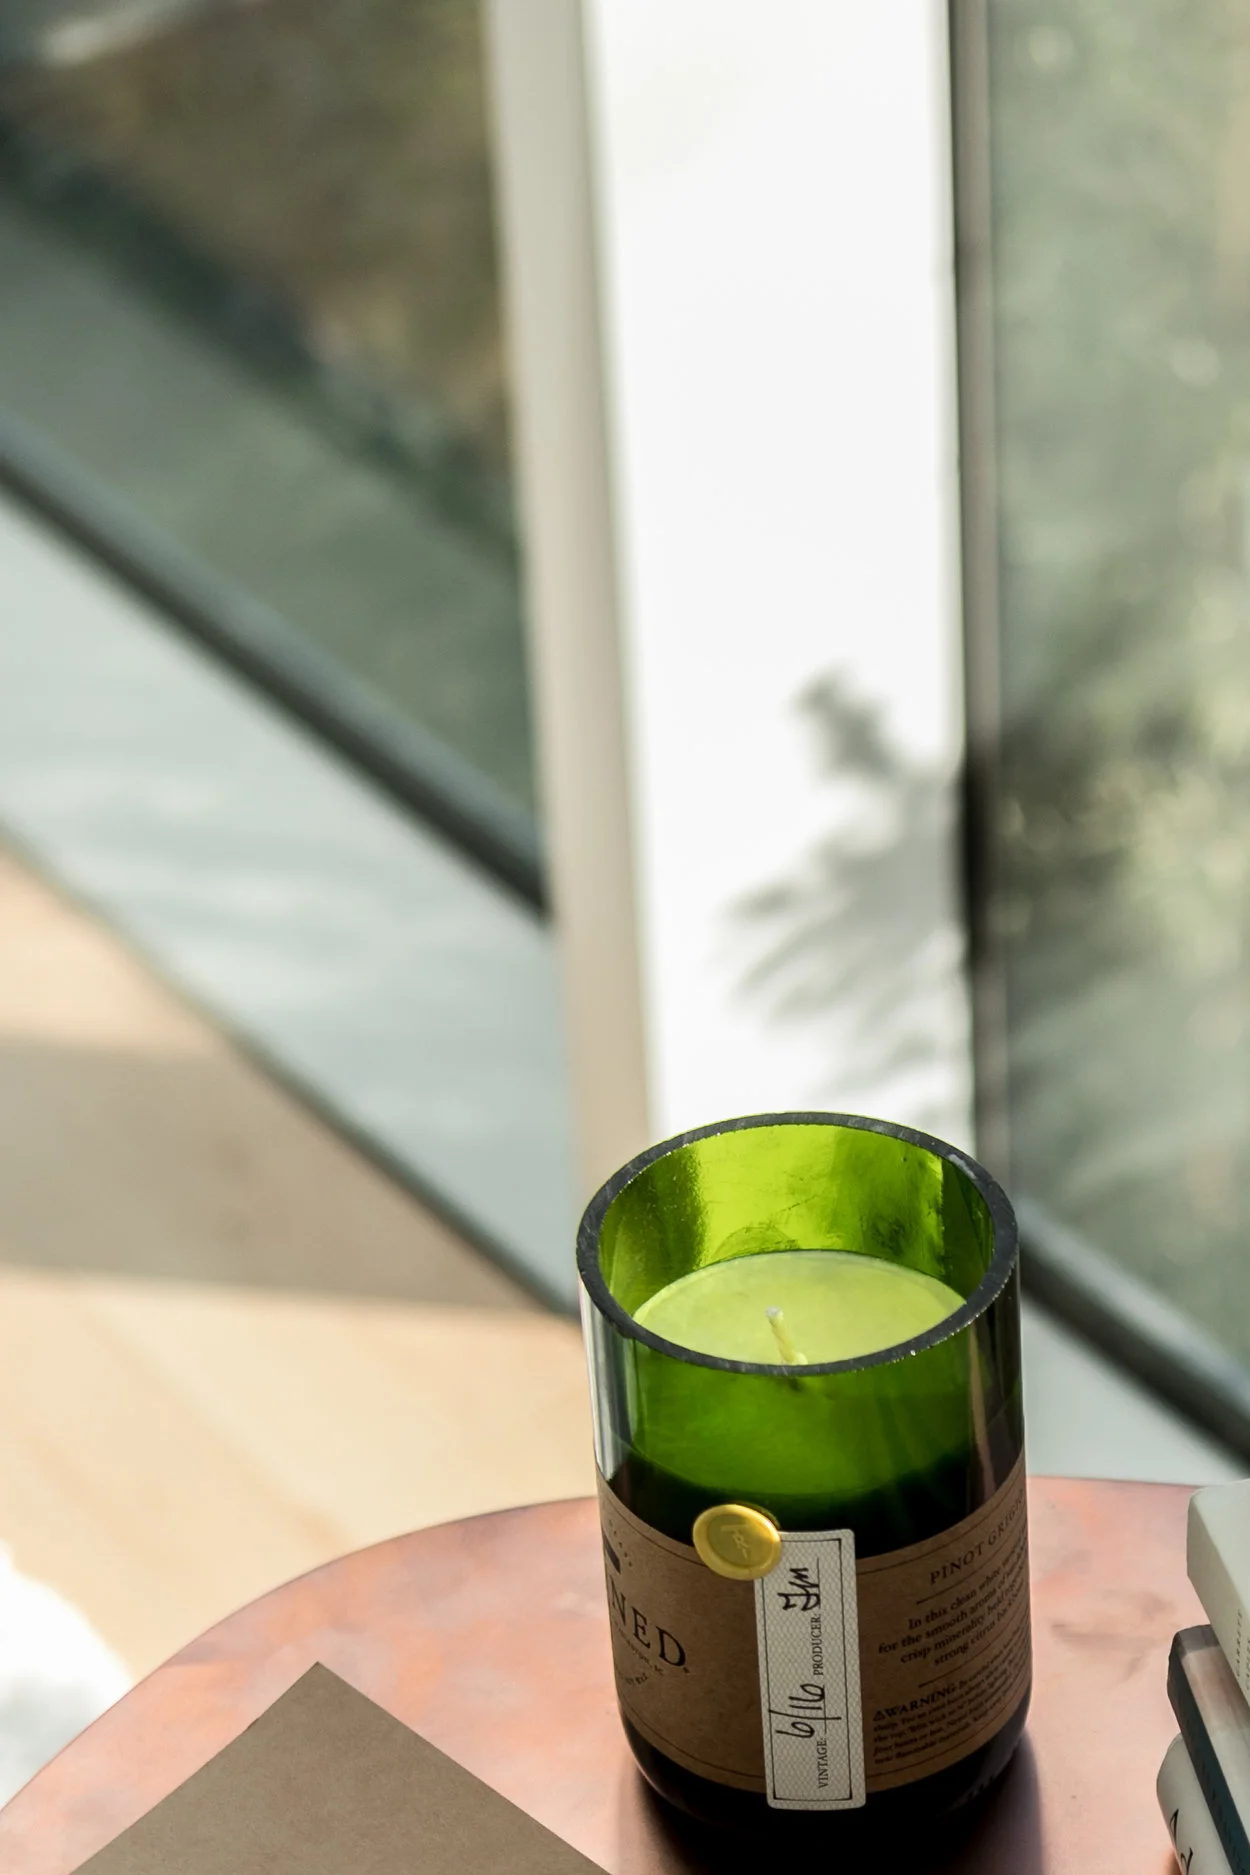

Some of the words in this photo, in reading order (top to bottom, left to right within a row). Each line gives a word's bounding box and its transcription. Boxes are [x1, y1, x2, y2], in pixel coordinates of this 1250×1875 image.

[929, 1541, 984, 1585] PINOT
[810, 1613, 825, 1677] PRODUCER:
[878, 1640, 899, 1655] for
[901, 1632, 923, 1649] the
[924, 1610, 968, 1640] smooth
[900, 1645, 932, 1664] crisp
[816, 1737, 828, 1789] VINTAGE:
